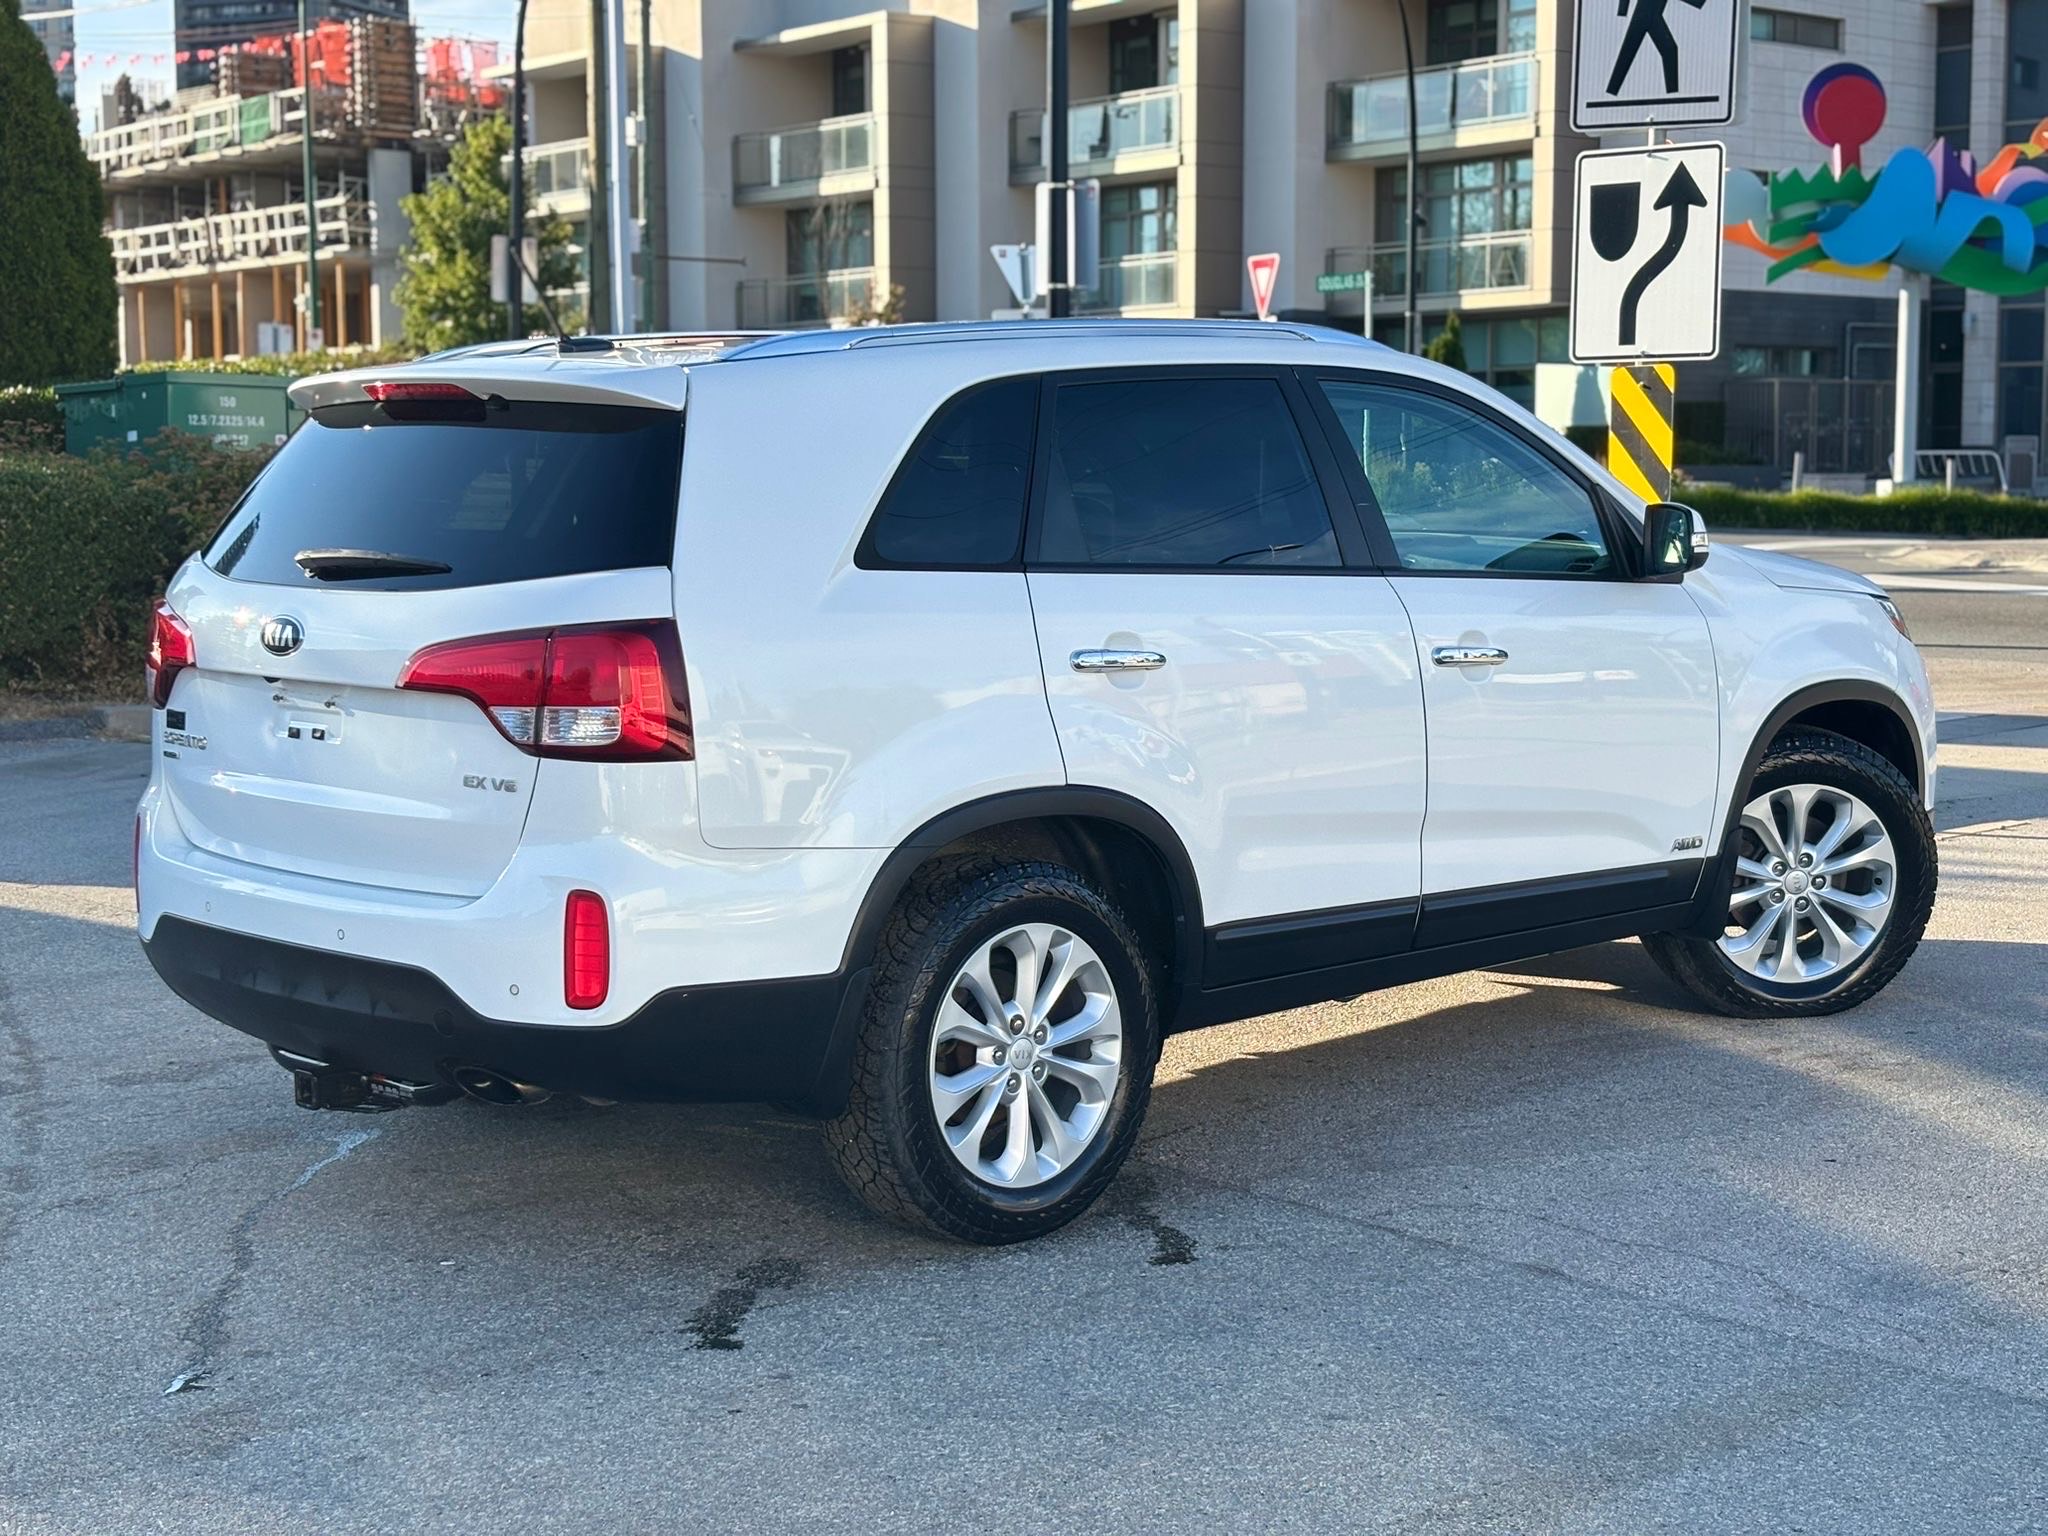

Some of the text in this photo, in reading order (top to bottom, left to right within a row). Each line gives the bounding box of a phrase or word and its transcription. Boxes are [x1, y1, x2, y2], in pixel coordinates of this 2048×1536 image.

[219, 396, 236, 408] 150
[264, 622, 294, 648] KIA
[463, 774, 487, 790] EX
[1670, 836, 1703, 853] AWD
